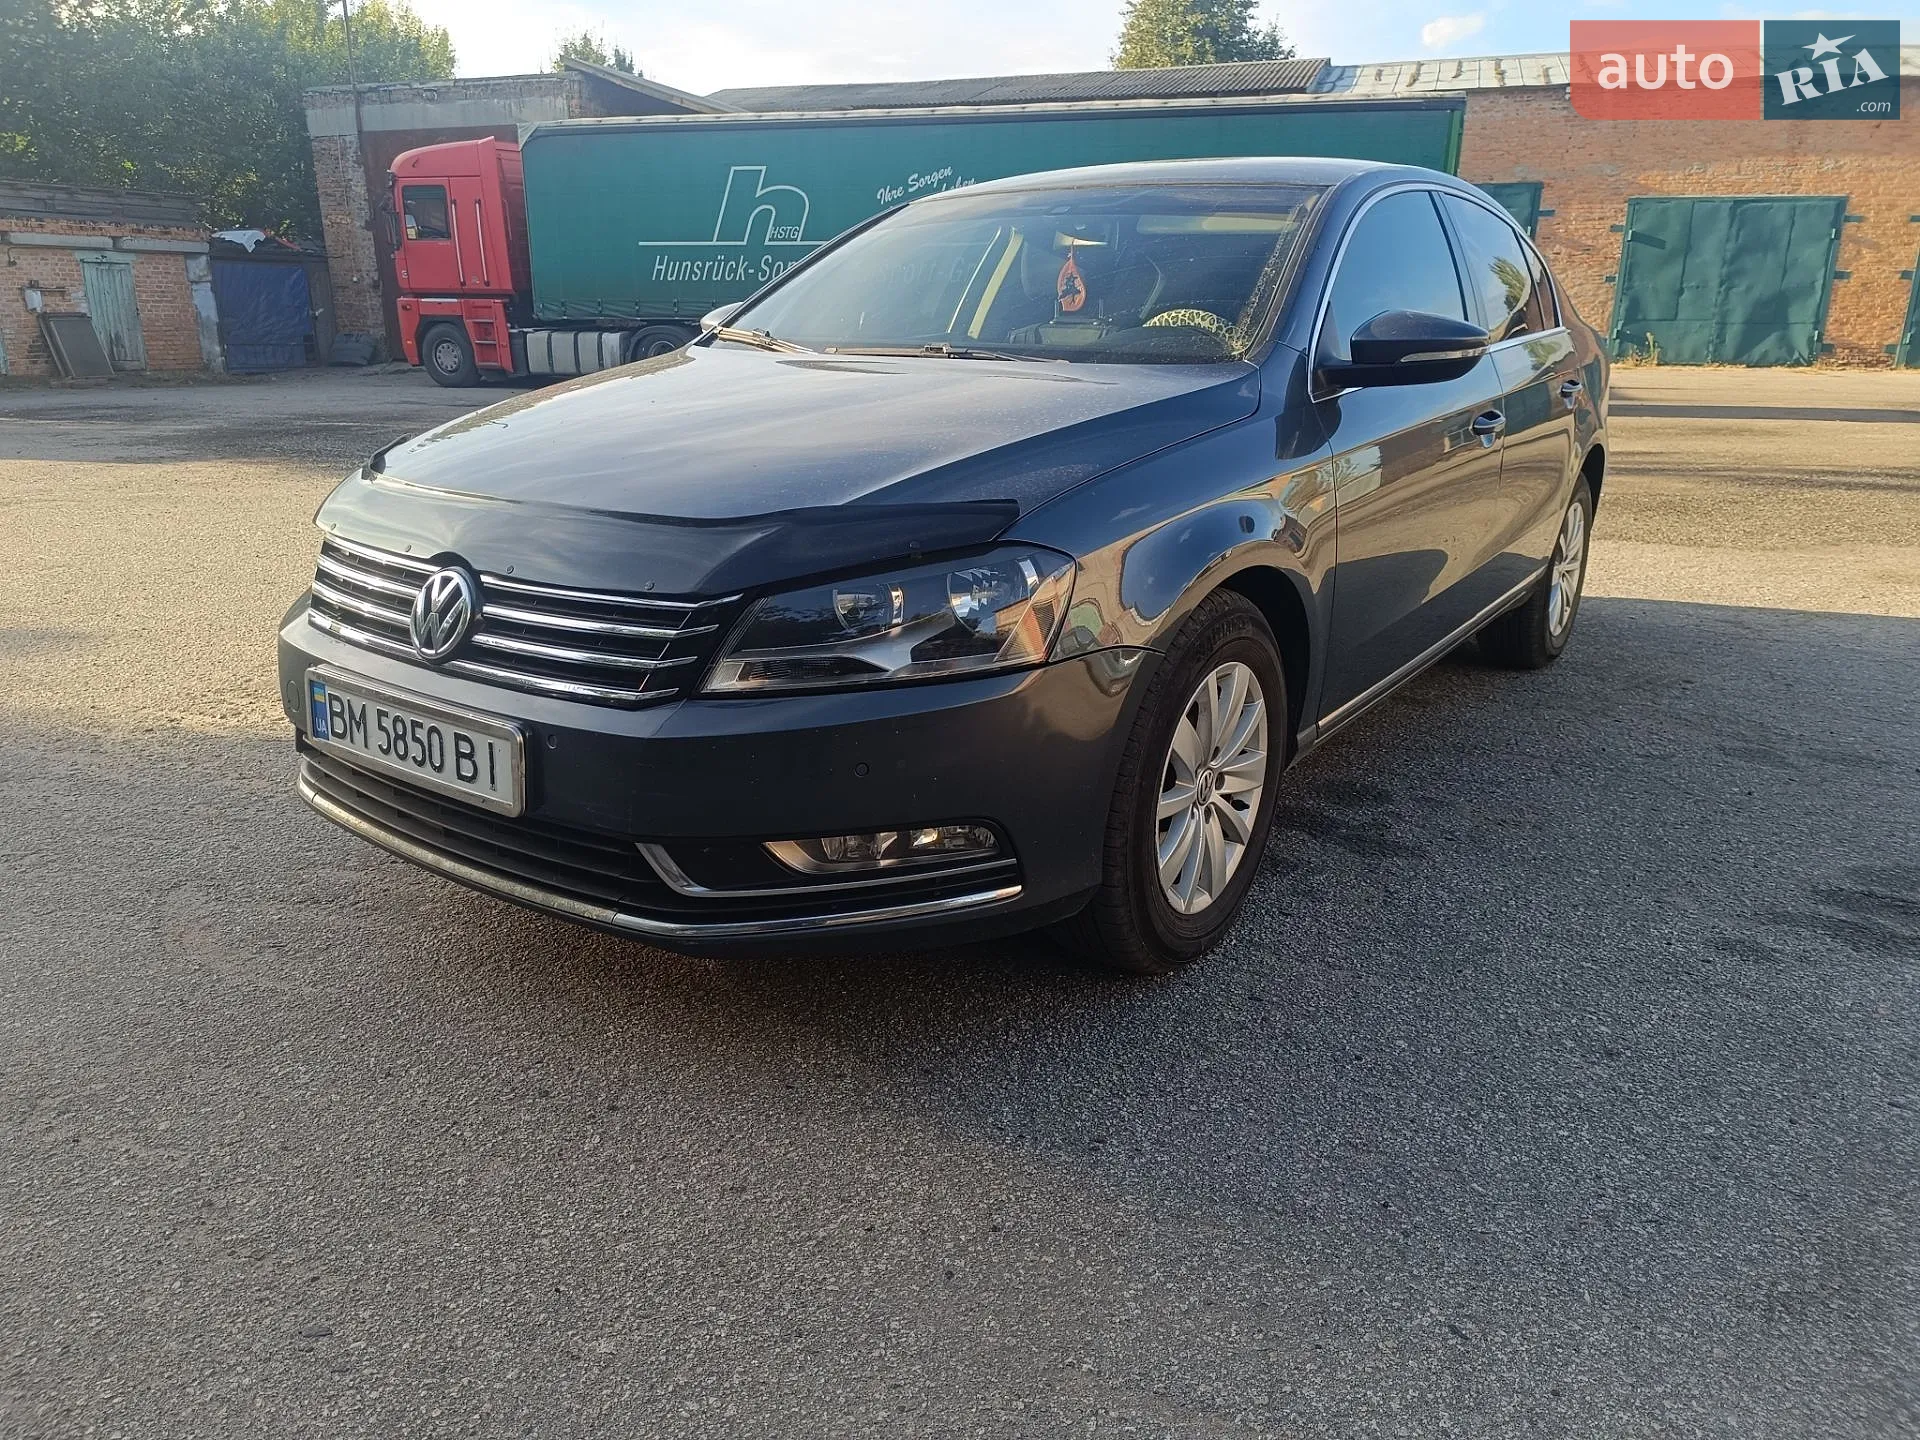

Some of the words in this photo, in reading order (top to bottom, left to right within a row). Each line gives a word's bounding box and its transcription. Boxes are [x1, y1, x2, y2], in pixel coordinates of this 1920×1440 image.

[876, 186, 904, 204] Ihre
[908, 166, 953, 193] Sorgen
[769, 226, 800, 239] HSTG
[315, 718, 328, 734] UA
[328, 691, 369, 749] BM
[376, 708, 444, 774] 5850
